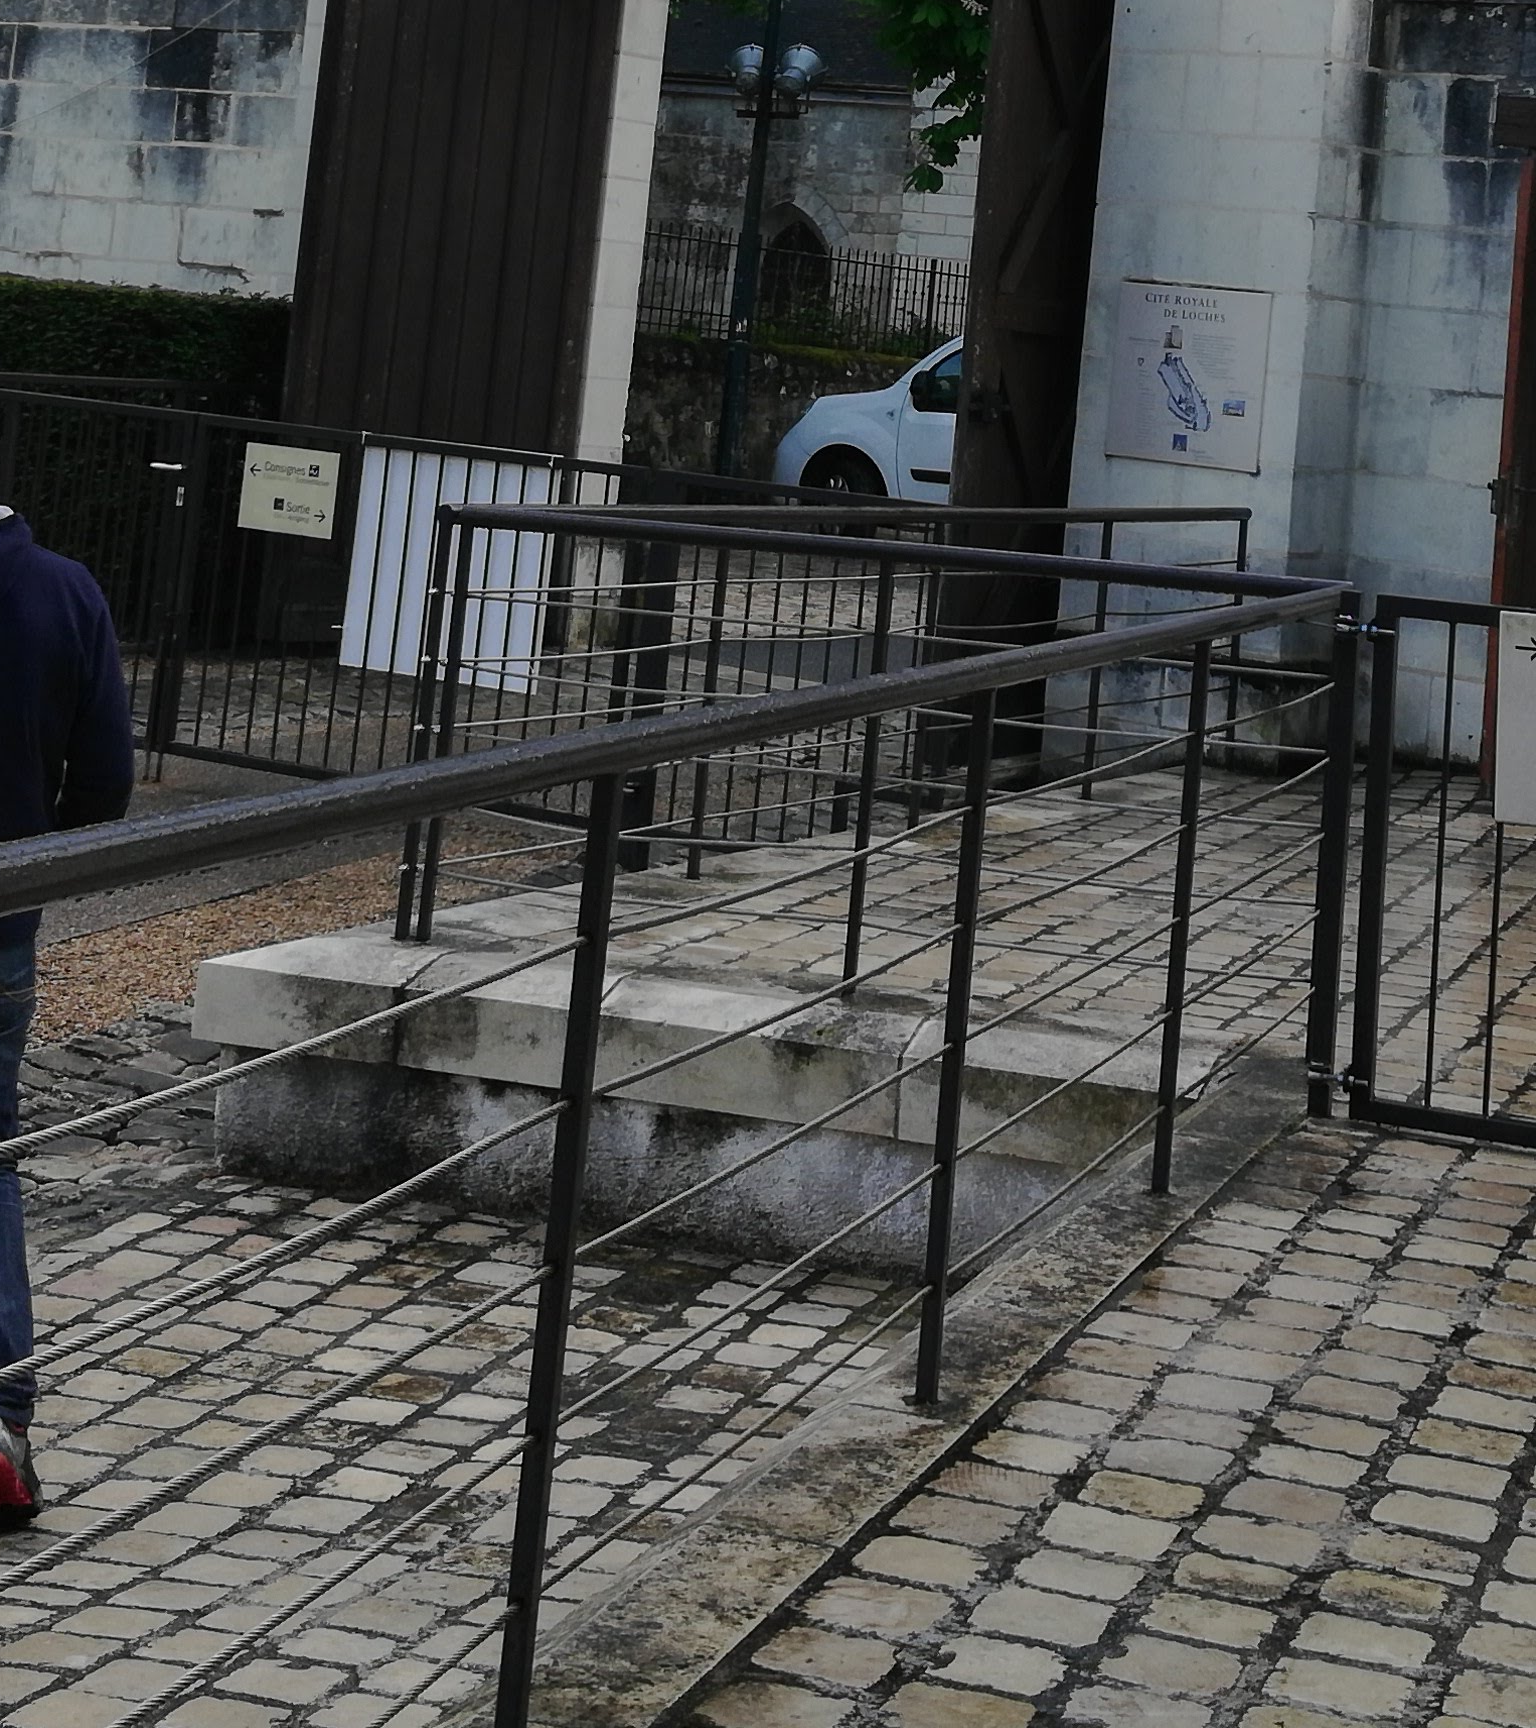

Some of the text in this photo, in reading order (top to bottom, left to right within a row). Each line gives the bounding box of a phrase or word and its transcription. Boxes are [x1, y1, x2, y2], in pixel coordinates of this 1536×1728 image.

[1164, 308, 1226, 323] DE LOCHES
[286, 501, 311, 514] Sortie
